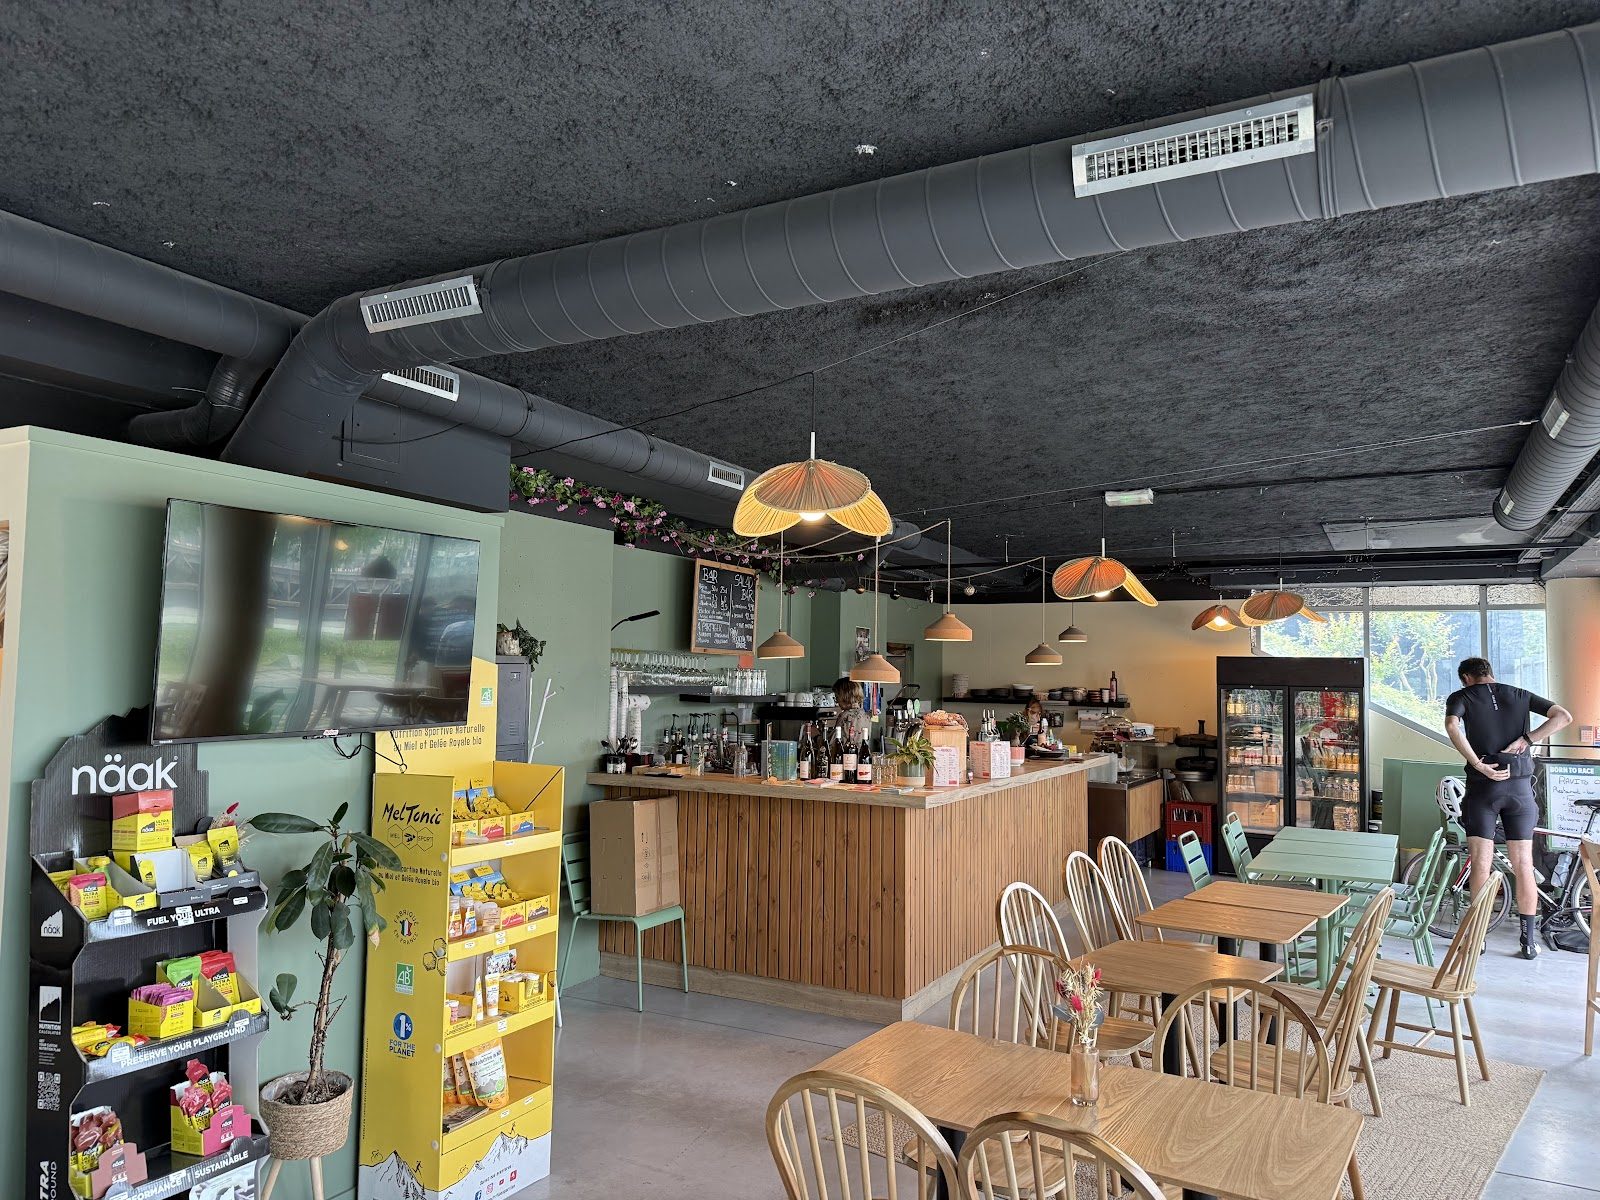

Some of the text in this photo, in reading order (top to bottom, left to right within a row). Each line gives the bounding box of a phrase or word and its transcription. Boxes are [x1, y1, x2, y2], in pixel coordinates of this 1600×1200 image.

[702, 567, 718, 584] BAR
[392, 723, 485, 738] utrition Sportive Naturelle
[404, 740, 418, 750] Miel
[419, 740, 427, 749] et
[429, 738, 447, 749] Gelée
[449, 736, 471, 748] Royale
[472, 736, 482, 745] bio
[71, 753, 178, 795] näak
[381, 801, 442, 825] MelTonic
[146, 906, 221, 927] FUEL YOUR ULTRA
[397, 970, 411, 985] AB
[399, 1014, 412, 1038] 1%
[120, 1026, 247, 1069] PRESERVE YOUR PLAYGROUND
[389, 1039, 416, 1051] FOR THE
[389, 1046, 415, 1057] PLANET
[194, 1150, 249, 1179] SUSTAINABLE
